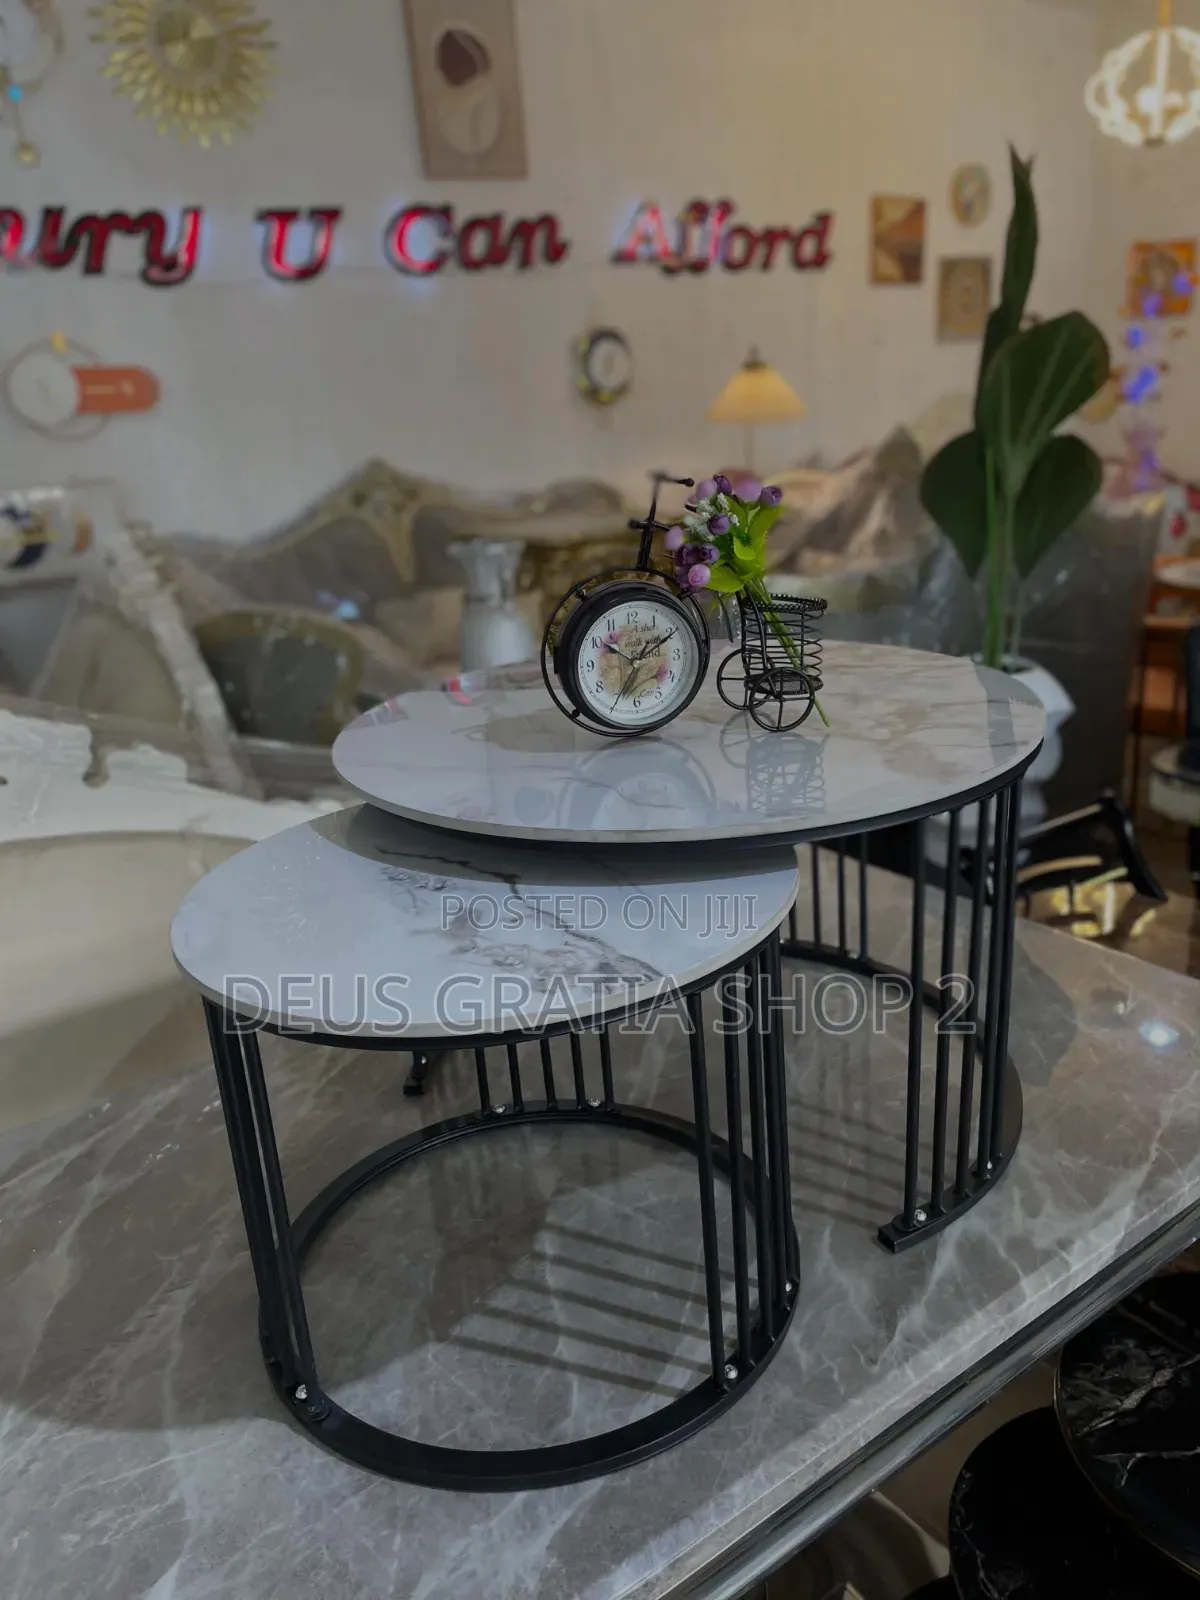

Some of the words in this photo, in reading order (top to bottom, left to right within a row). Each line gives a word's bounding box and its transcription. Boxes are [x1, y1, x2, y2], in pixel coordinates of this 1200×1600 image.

[255, 205, 343, 283] U
[384, 203, 572, 276] Can
[609, 197, 834, 276] Afford
[627, 611, 638, 625] 12
[607, 619, 615, 632] 11
[666, 627, 674, 640] 2
[592, 636, 602, 649] 10
[673, 648, 681, 661] 3
[587, 660, 595, 673] 9
[669, 671, 675, 683] 4
[596, 681, 604, 694] 8
[655, 687, 662, 700] 5
[634, 696, 641, 708] 6
